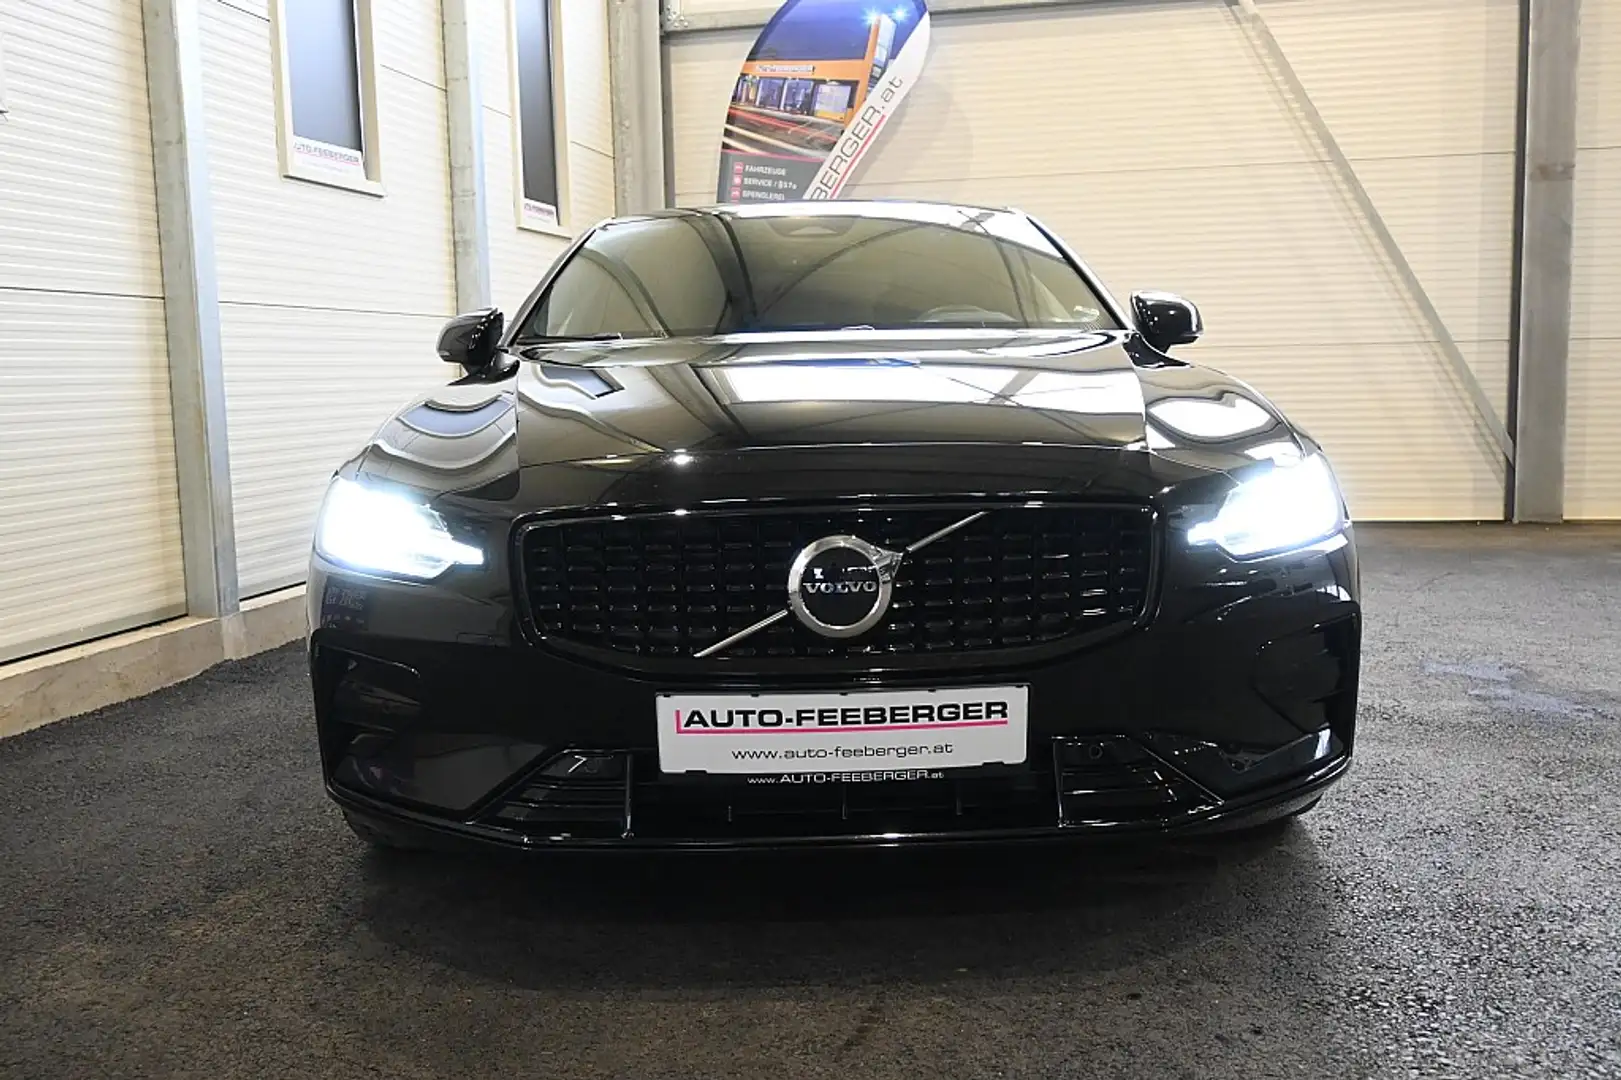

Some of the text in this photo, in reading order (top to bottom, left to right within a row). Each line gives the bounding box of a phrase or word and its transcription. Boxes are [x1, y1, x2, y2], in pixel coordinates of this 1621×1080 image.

[744, 164, 787, 176] FAHRZEUGE
[743, 177, 772, 187] SERVICE
[742, 190, 785, 200] SPENGLEREI
[803, 581, 877, 593] VOLVO
[684, 701, 1008, 728] AUTO-FEEBERGER
[732, 743, 953, 760] www.auto-feeberger.at
[747, 769, 945, 784] www.AUTO-FEEBERGER.at
